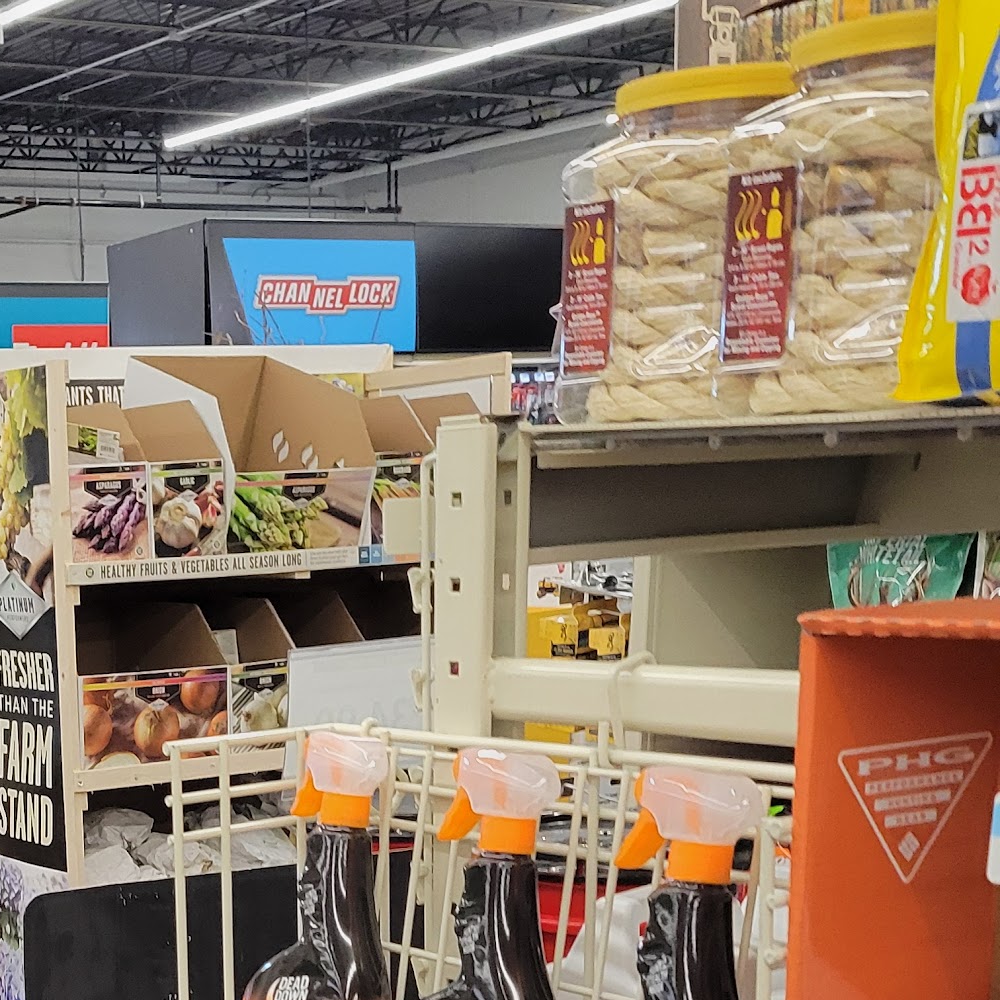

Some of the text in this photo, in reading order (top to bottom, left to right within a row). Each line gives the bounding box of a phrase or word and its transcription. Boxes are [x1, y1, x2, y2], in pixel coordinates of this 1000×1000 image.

[66, 385, 93, 407] ANTS
[100, 562, 137, 579] HEALTHY
[140, 560, 169, 577] FRUITS
[171, 560, 178, 575] &
[180, 557, 230, 575] VEGETABLES
[232, 556, 248, 571] ALL
[249, 554, 281, 570] SEASON
[282, 552, 303, 568] LONG
[32, 697, 54, 718] THE
[858, 746, 975, 776] PHG
[279, 975, 309, 990] DEAD
